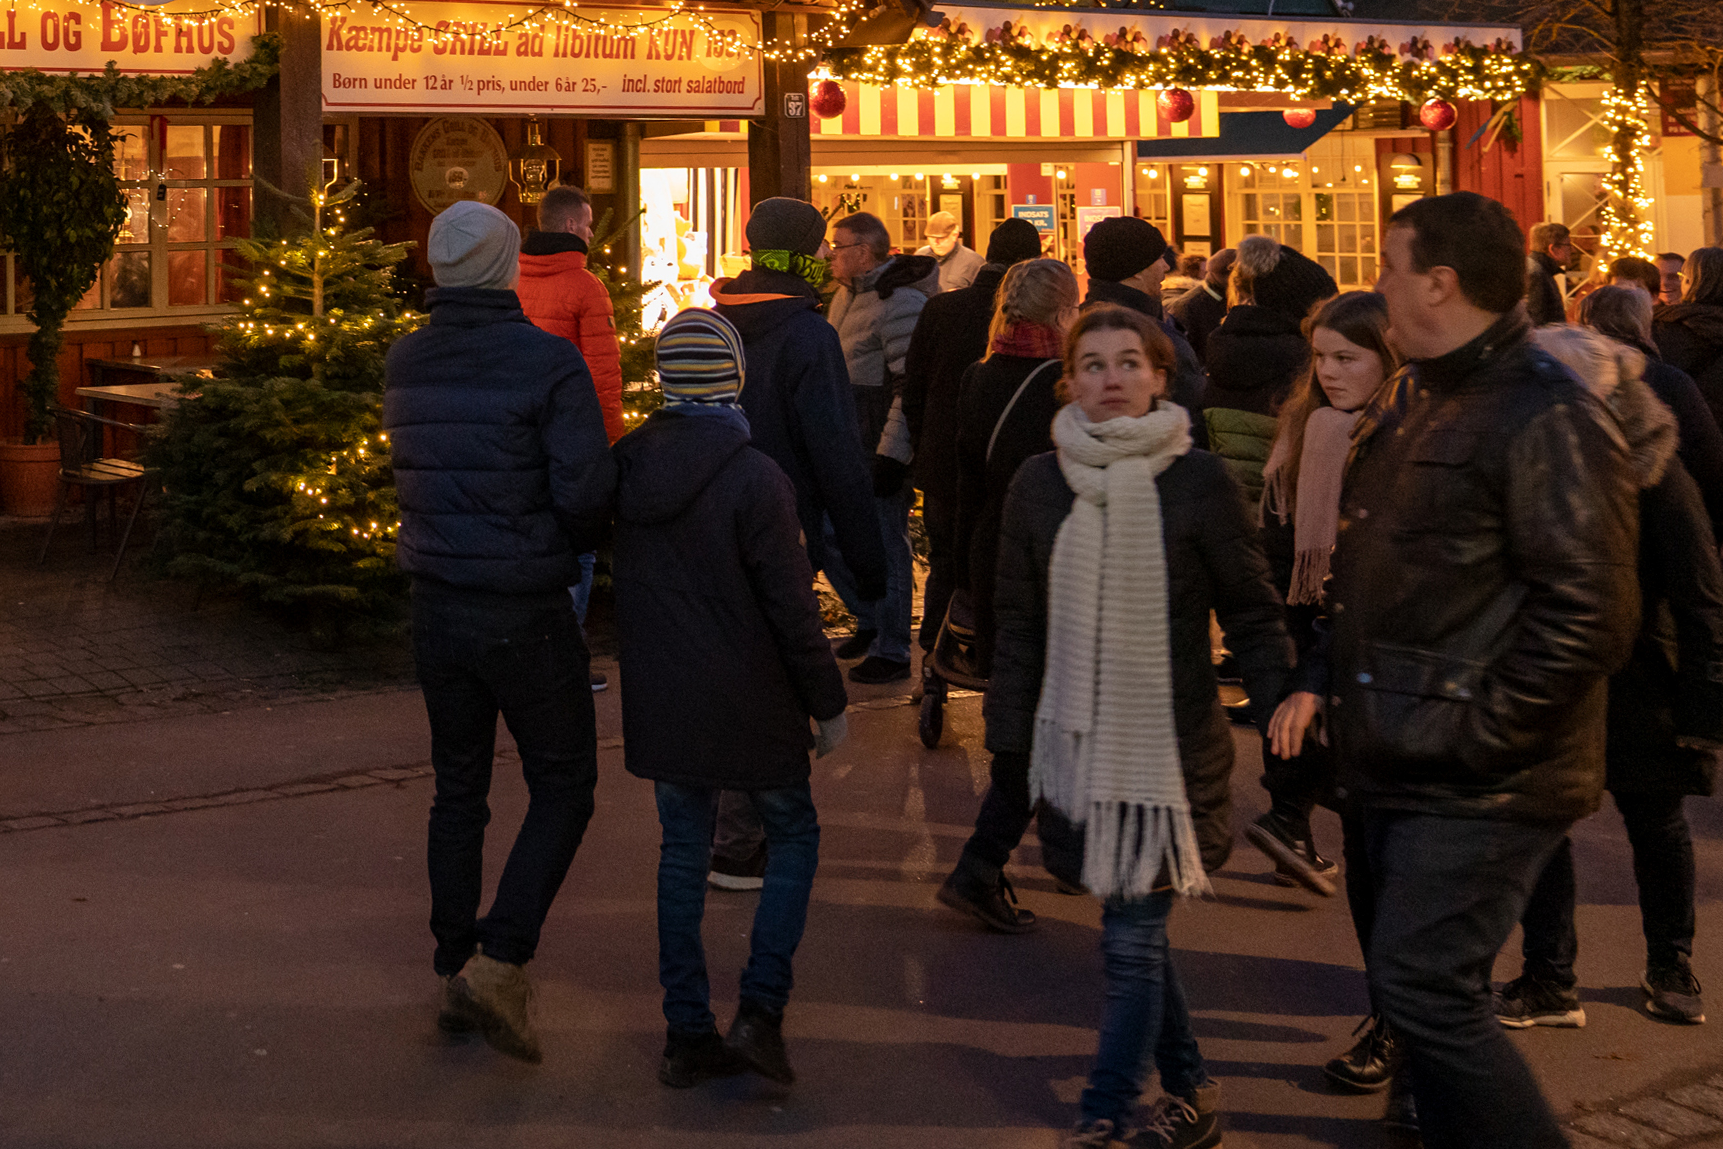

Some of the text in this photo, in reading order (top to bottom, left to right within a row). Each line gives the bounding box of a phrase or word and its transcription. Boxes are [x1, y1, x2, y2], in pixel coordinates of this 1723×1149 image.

[40, 10, 82, 52] OG
[332, 72, 368, 90] Børn
[374, 73, 417, 91] under
[510, 76, 549, 92] under
[622, 74, 746, 95] incl. stort salatbord
[789, 102, 802, 116] 37
